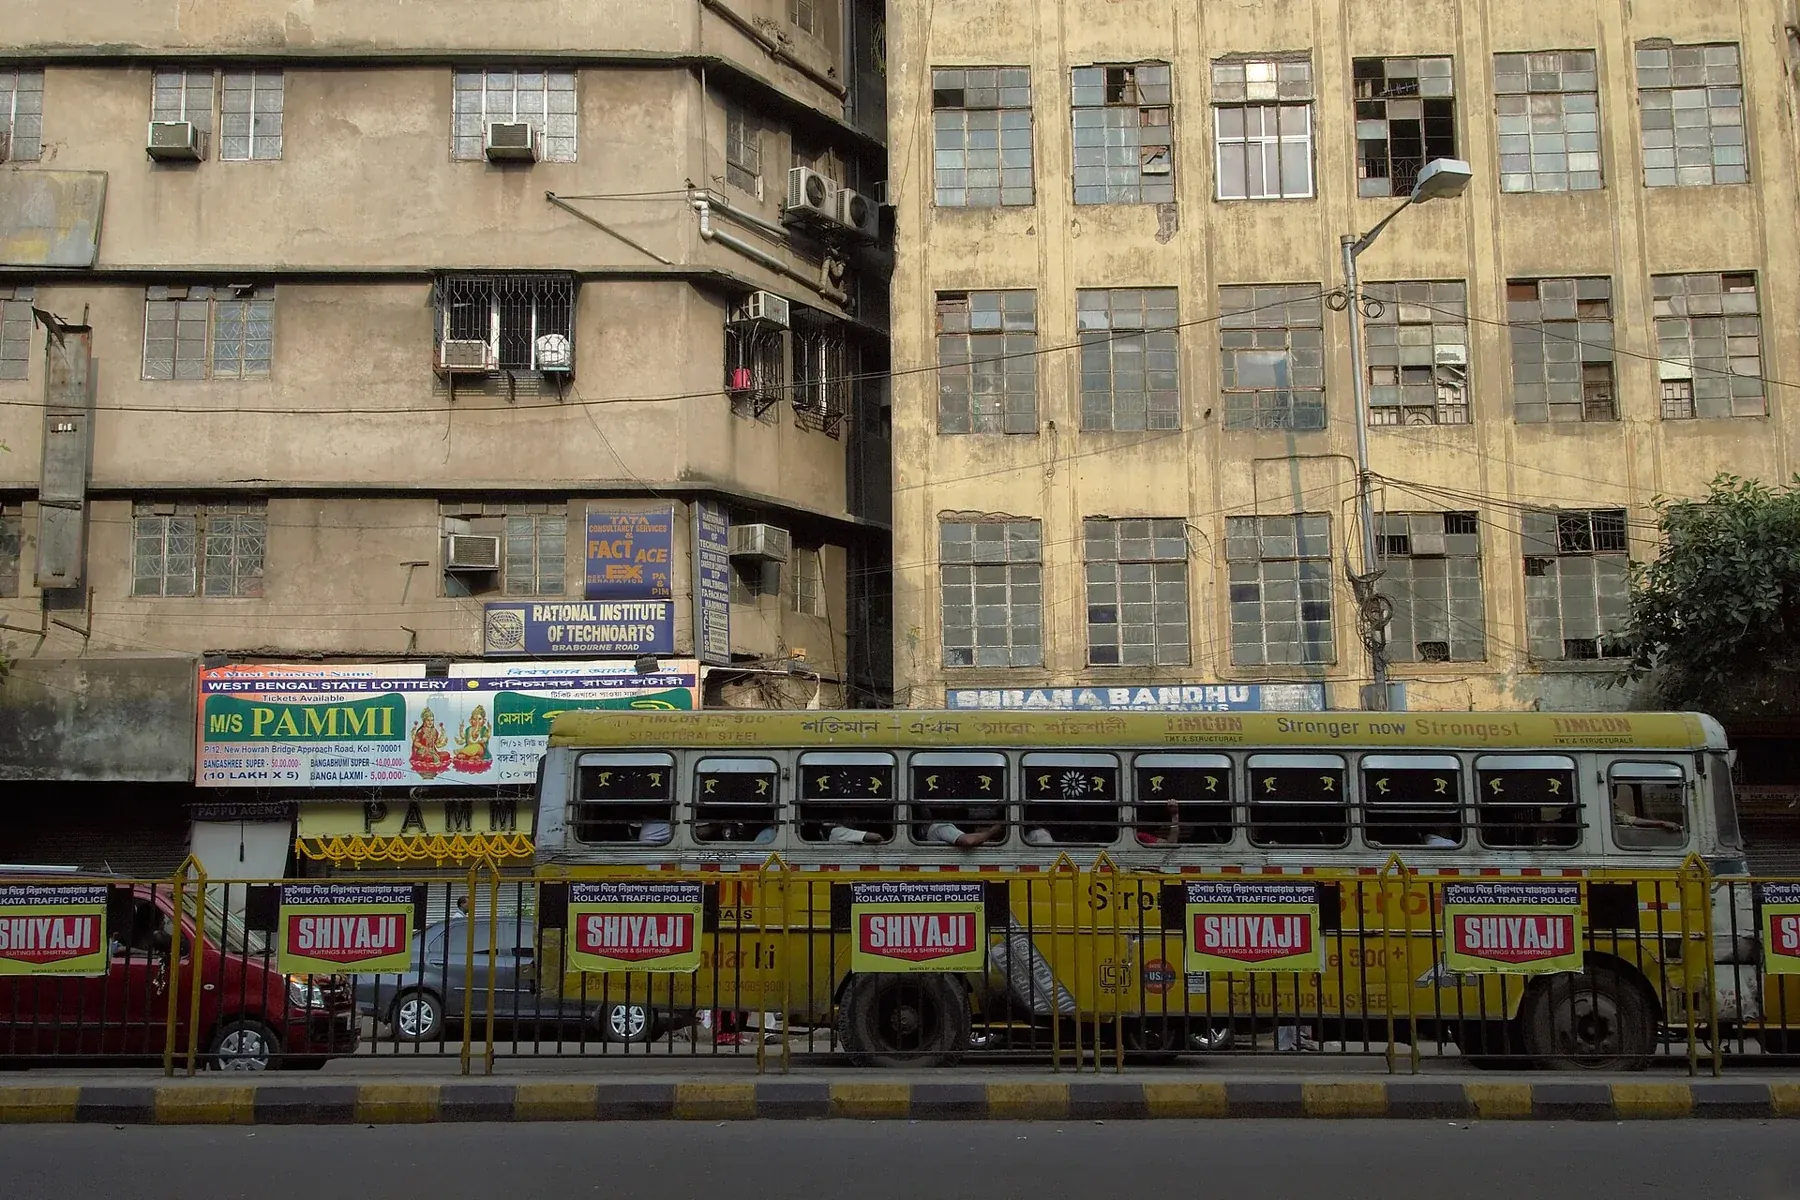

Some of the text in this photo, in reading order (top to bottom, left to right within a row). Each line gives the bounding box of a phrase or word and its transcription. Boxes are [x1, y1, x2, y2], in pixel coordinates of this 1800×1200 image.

[610, 516, 649, 525] TATA
[589, 525, 667, 533] CONSULTANCY SERVICES
[589, 541, 633, 559] FACT
[635, 549, 668, 563] ACE
[606, 565, 643, 580] EX
[533, 603, 666, 621] RATIONAL INSTITUTE
[548, 625, 655, 642] OF TECHNOARTS
[208, 682, 251, 690] WEST
[255, 682, 317, 690] BENGAL
[321, 681, 367, 689] STATE
[300, 694, 345, 702] Available
[1107, 685, 1249, 705] BANDHU
[210, 707, 395, 737] M/S PAMMI
[801, 716, 880, 734] শক্তিমান
[1277, 717, 1521, 740] Stronger now Strongest
[224, 744, 401, 756] New Howrah Bridge Approach Road, Kol 700001
[204, 758, 264, 769] BANGASHREE SUPER
[310, 758, 370, 768] BANGABHUMI SUPER
[204, 771, 224, 780] (10
[230, 771, 267, 779] LAKH
[287, 771, 299, 780] 5)
[310, 772, 337, 780] BANGA
[340, 771, 363, 780] LAXMI
[241, 805, 289, 816] AGENCY
[28, 896, 107, 904] TRAFFIC POLICE
[286, 895, 411, 904] KOLKATA TRAFFIC POLICE
[574, 894, 698, 902] KOLKATA TRAFFIC POLICE
[856, 894, 979, 902] KOLKATA TRAFFIC POLICE
[1190, 895, 1314, 903] KOLKATA TRAFFIC POLICE
[1449, 896, 1577, 904] KOLKATA TRAFFIC POLICE
[0, 917, 91, 949] SHIYAJI
[299, 917, 396, 949] SHIYAJI
[587, 916, 683, 947] SHIYAJI
[870, 916, 966, 947] SHIYAJI
[1204, 916, 1301, 948] SHIYAJI
[1465, 918, 1564, 949] SHIYAJI
